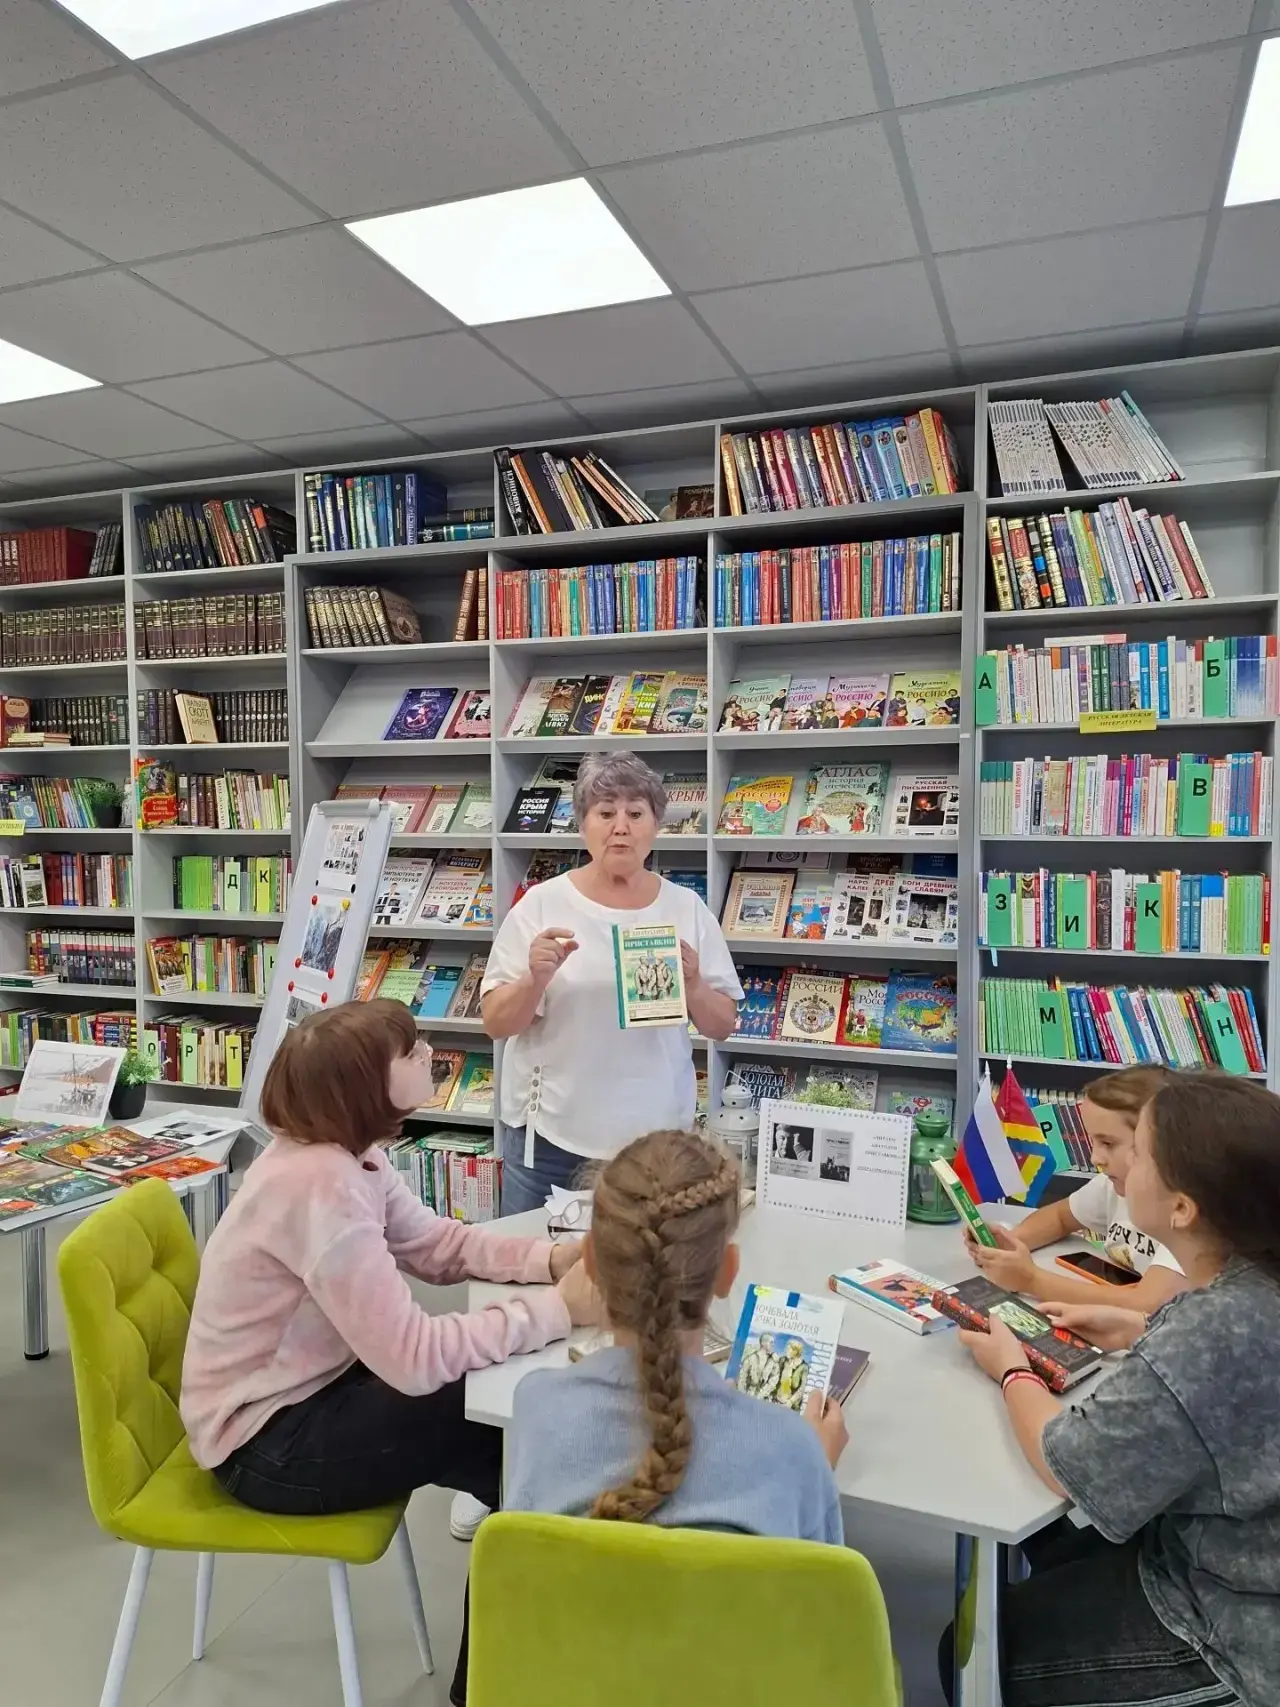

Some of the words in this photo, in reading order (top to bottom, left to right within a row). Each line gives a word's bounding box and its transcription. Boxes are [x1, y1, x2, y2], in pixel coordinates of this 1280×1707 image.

[1206, 659, 1221, 677] Б
[978, 673, 992, 690] А
[739, 694, 774, 705] РОССИЮ
[787, 693, 813, 702] ССИЮ
[835, 692, 873, 701] РОССИЮ
[907, 689, 947, 698] РОССИЮ
[820, 766, 878, 777] АТЛАС
[1192, 777, 1207, 796] В
[668, 790, 708, 802] КРЫМ
[227, 873, 238, 889] Д
[259, 869, 269, 883] К
[995, 894, 1007, 910] З
[1144, 899, 1160, 918] К
[1064, 915, 1079, 932] И
[792, 982, 843, 994] РОССИИ
[867, 988, 887, 999] Мо
[1039, 1007, 1056, 1025] М
[1217, 1017, 1235, 1037] Н
[185, 1045, 194, 1057] Р
[229, 1046, 238, 1059] Т
[742, 1071, 785, 1087] ЗОЛОТАЯ
[747, 1084, 781, 1099] НИГА
[1040, 1120, 1053, 1139] Р
[779, 1318, 820, 1335] ЗОЛОТАЯ
